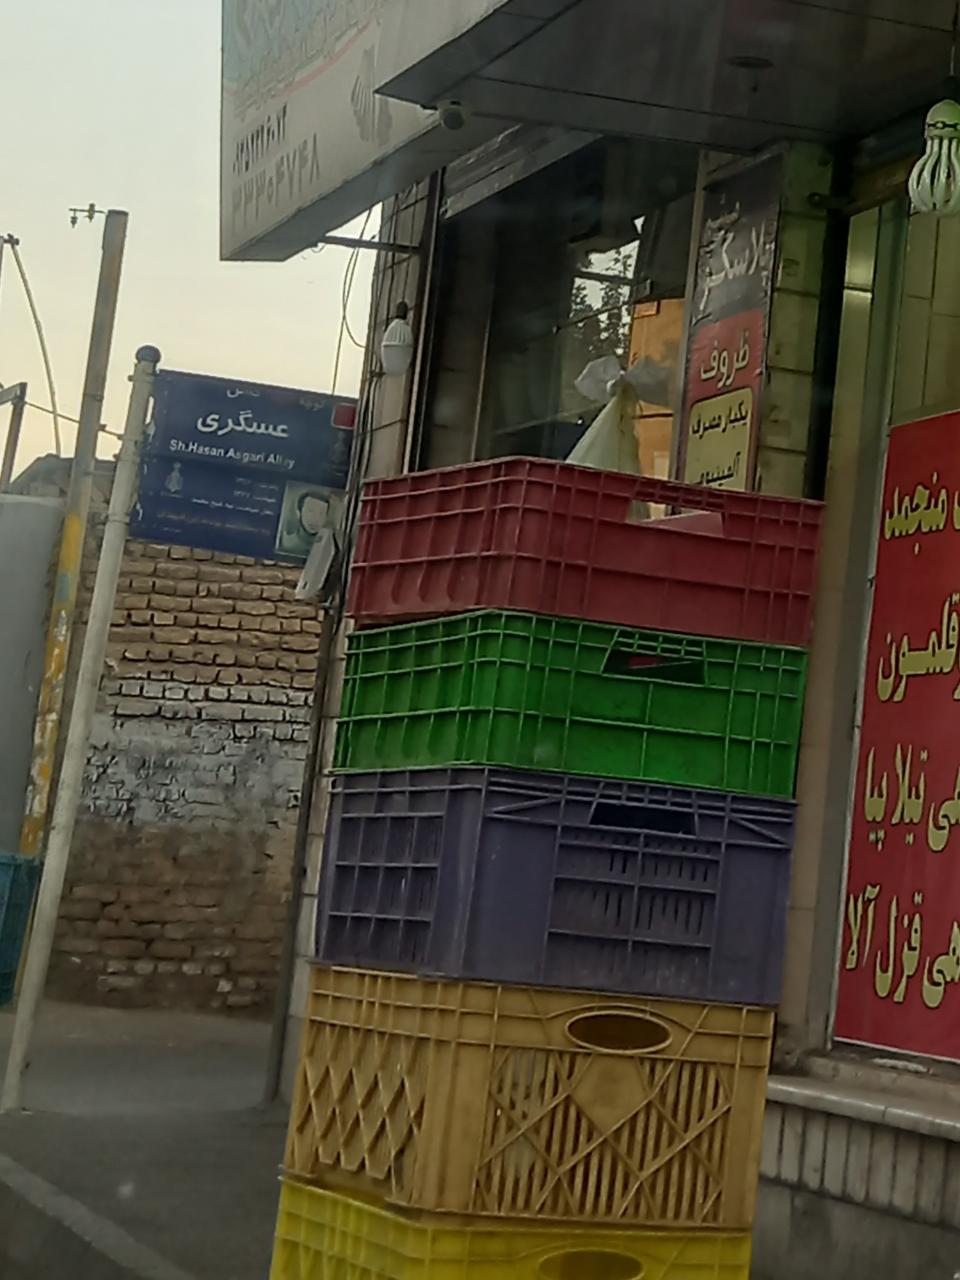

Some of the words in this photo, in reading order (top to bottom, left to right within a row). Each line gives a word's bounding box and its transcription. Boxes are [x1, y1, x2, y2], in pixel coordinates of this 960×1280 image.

[700, 329, 750, 388] ظروف
[196, 410, 289, 438] عسگری
[692, 413, 721, 440] مصرف
[722, 400, 748, 433] یکبار
[227, 448, 265, 463] Asgari
[883, 472, 948, 555] منجمد
[845, 883, 881, 973] آلا
[874, 892, 922, 1004] قزل
